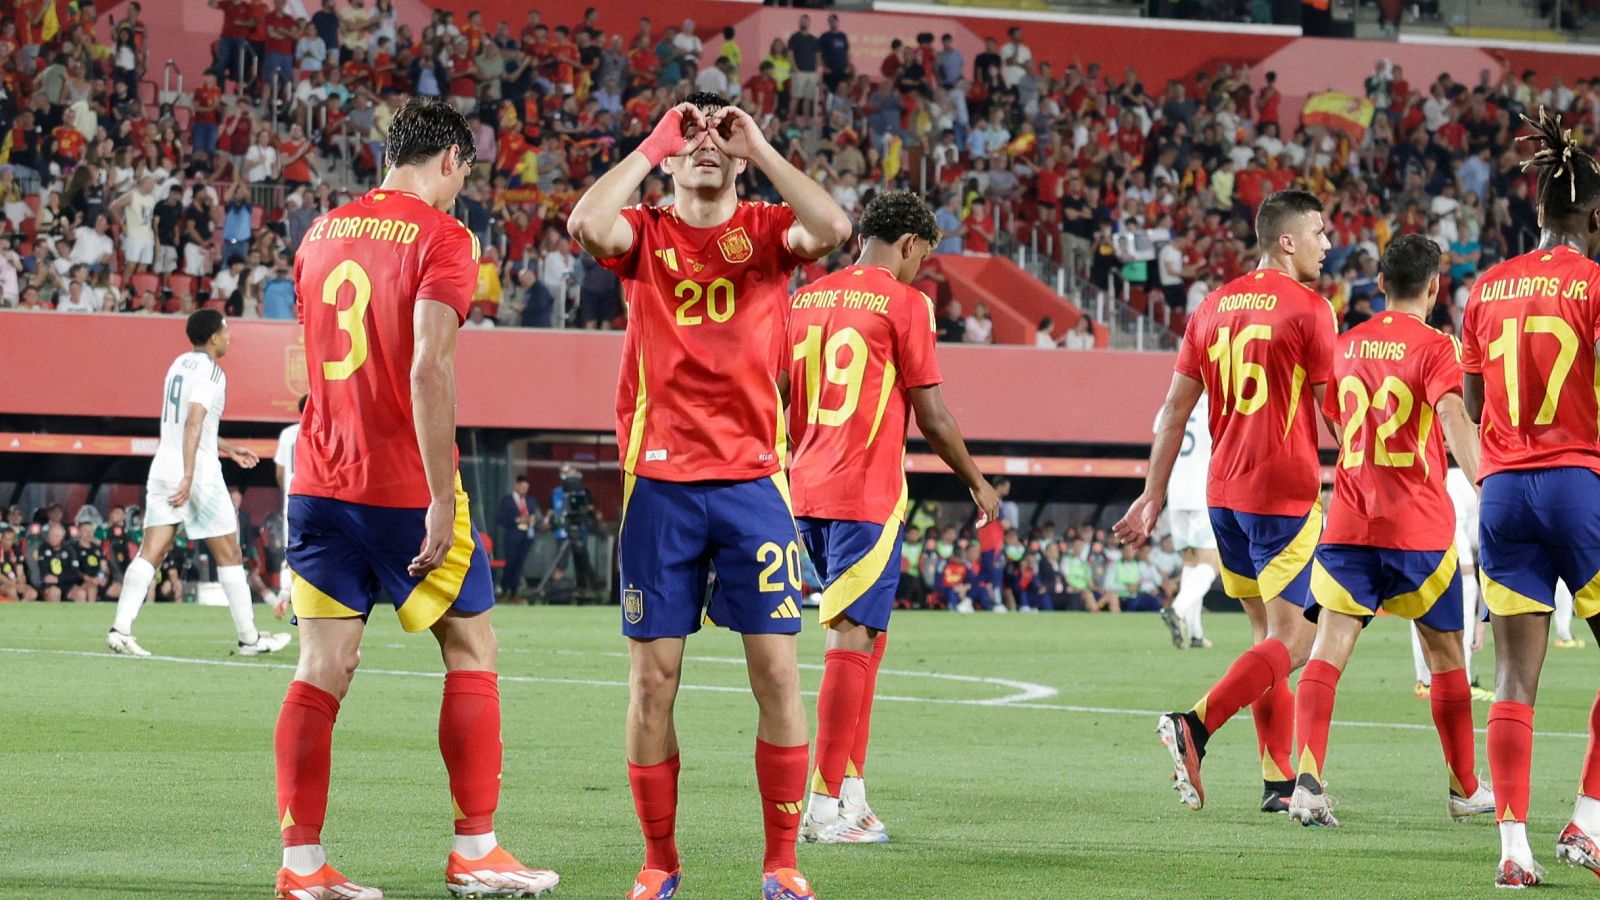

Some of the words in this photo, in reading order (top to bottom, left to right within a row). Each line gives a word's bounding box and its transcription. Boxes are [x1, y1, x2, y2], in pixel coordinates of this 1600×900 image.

[309, 218, 328, 242] LE
[326, 216, 420, 245] NORMAND
[674, 277, 736, 326] 20
[792, 289, 841, 310] LAMINE
[843, 290, 891, 314] YAMAL
[1217, 294, 1277, 314] RODRIGO
[1480, 276, 1560, 303] WILLIAMS
[1562, 279, 1588, 300] JR.
[322, 259, 372, 382] 3
[791, 323, 870, 427] 19
[1207, 323, 1275, 416] 16
[1344, 340, 1356, 359] J.
[1360, 339, 1407, 361] NAVAS
[1488, 315, 1580, 428] 17
[163, 374, 184, 424] 19
[1336, 375, 1416, 468] 22
[756, 540, 803, 593] 20
